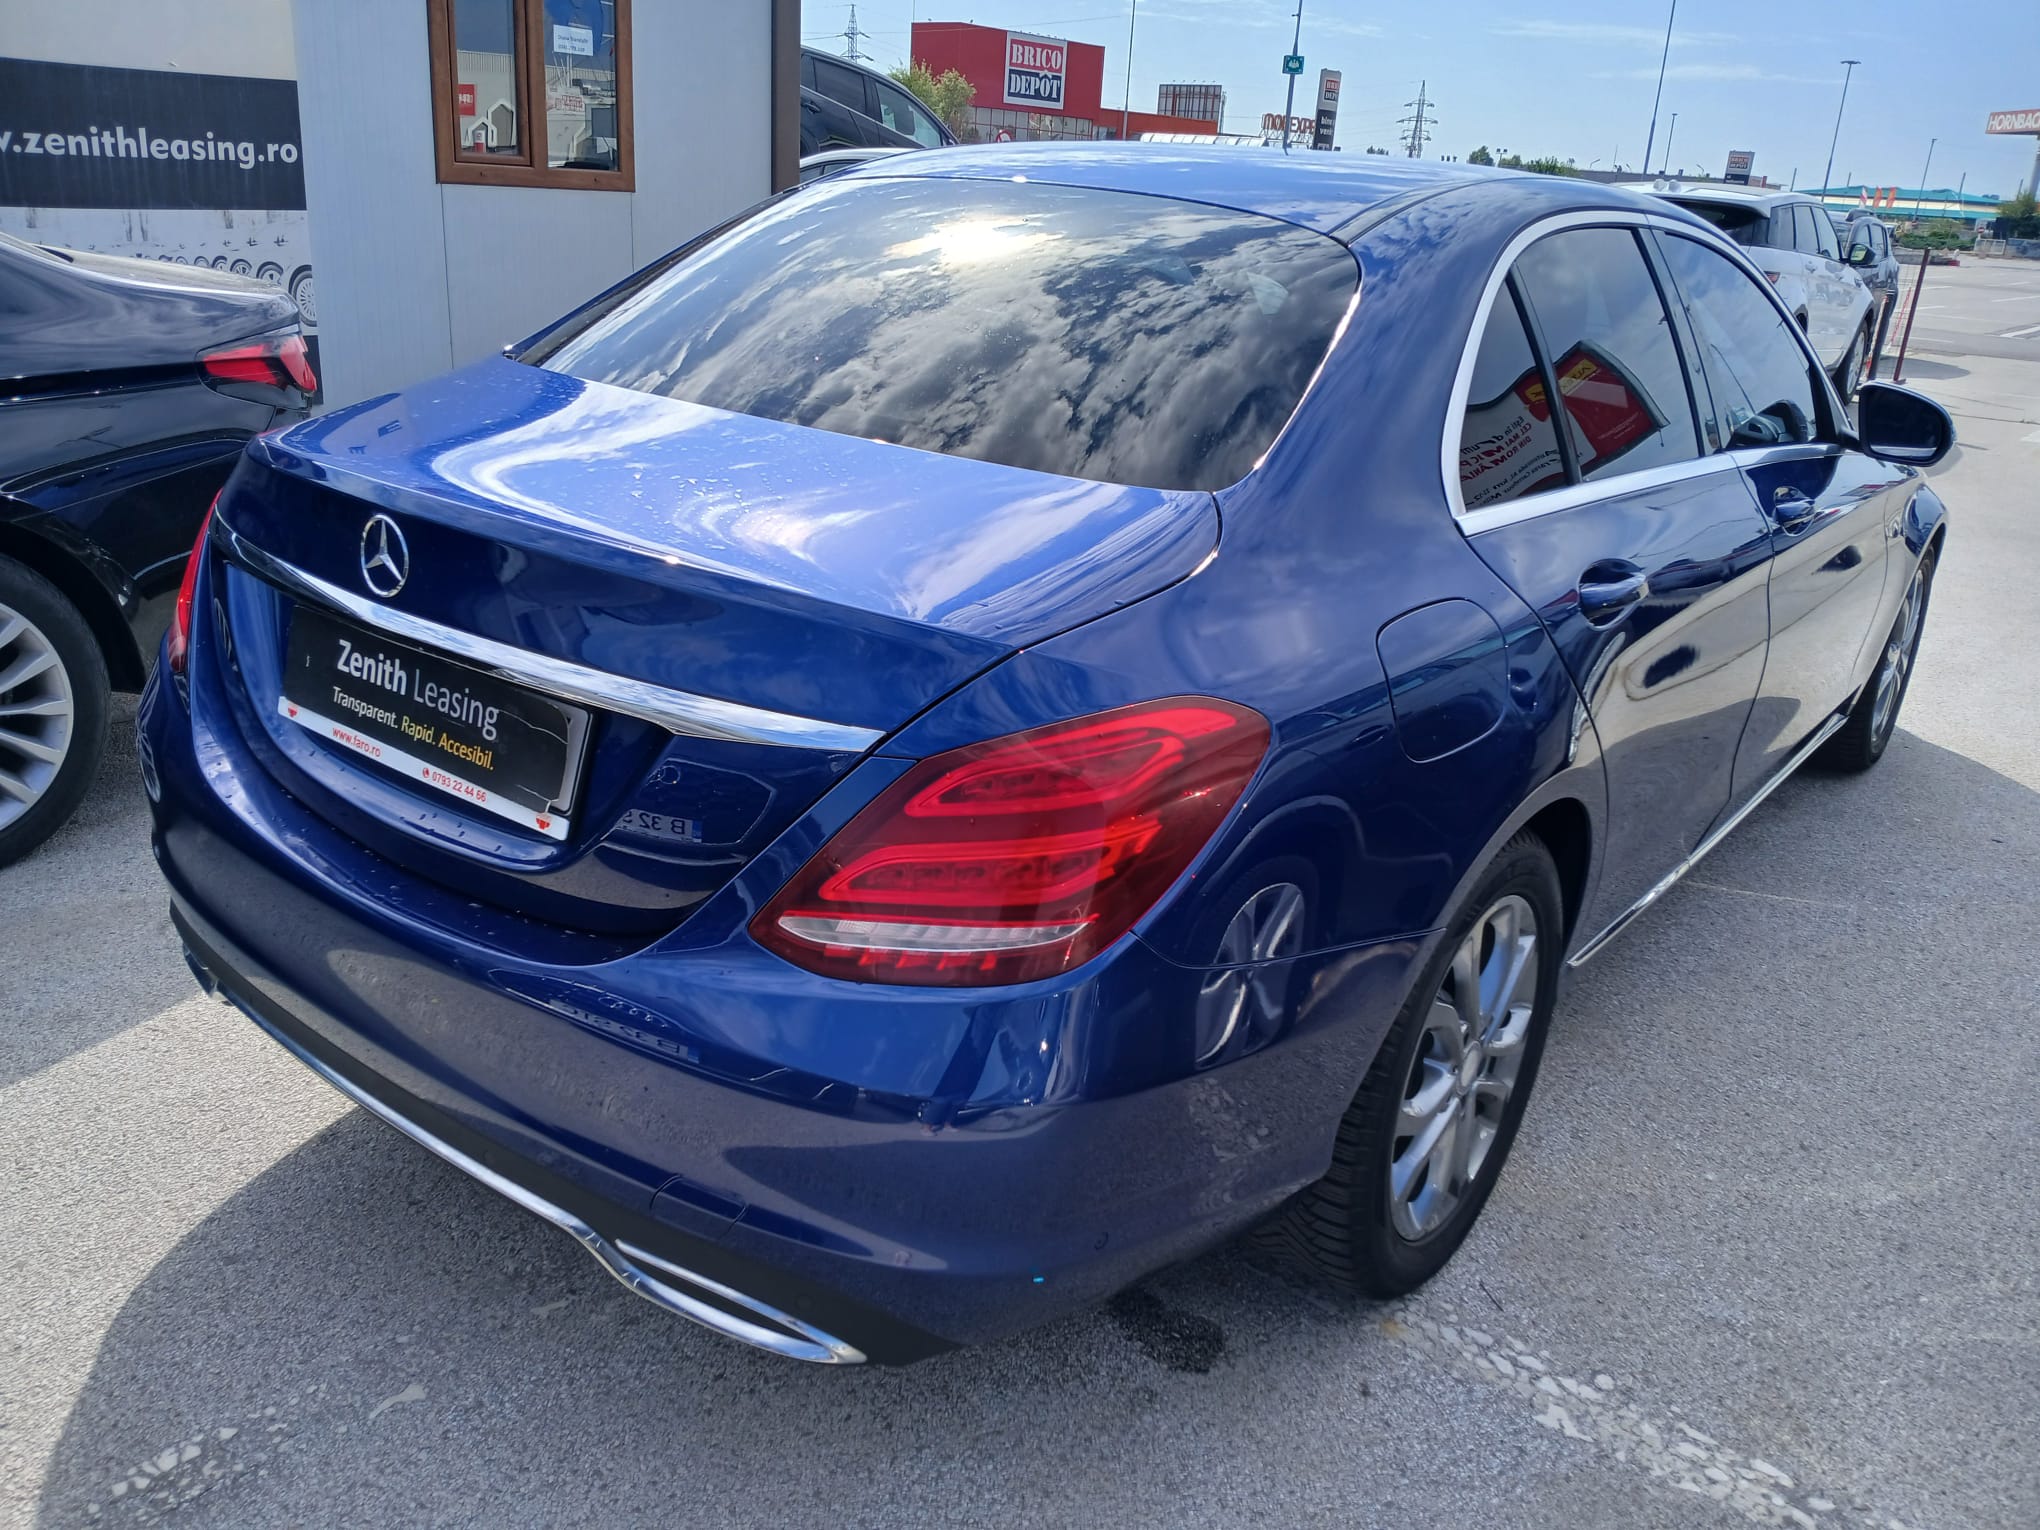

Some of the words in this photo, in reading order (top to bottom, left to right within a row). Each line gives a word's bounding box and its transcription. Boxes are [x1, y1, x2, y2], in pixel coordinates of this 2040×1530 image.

[1011, 43, 1062, 70] BRICO
[337, 639, 407, 696] Zenith
[413, 668, 500, 741] Leasing
[332, 686, 398, 729] Transparent.
[401, 715, 436, 746] Rapid.
[438, 732, 494, 771] Accesibil.
[432, 771, 451, 788] 0793
[452, 780, 463, 793] 22
[464, 785, 475, 797] 44
